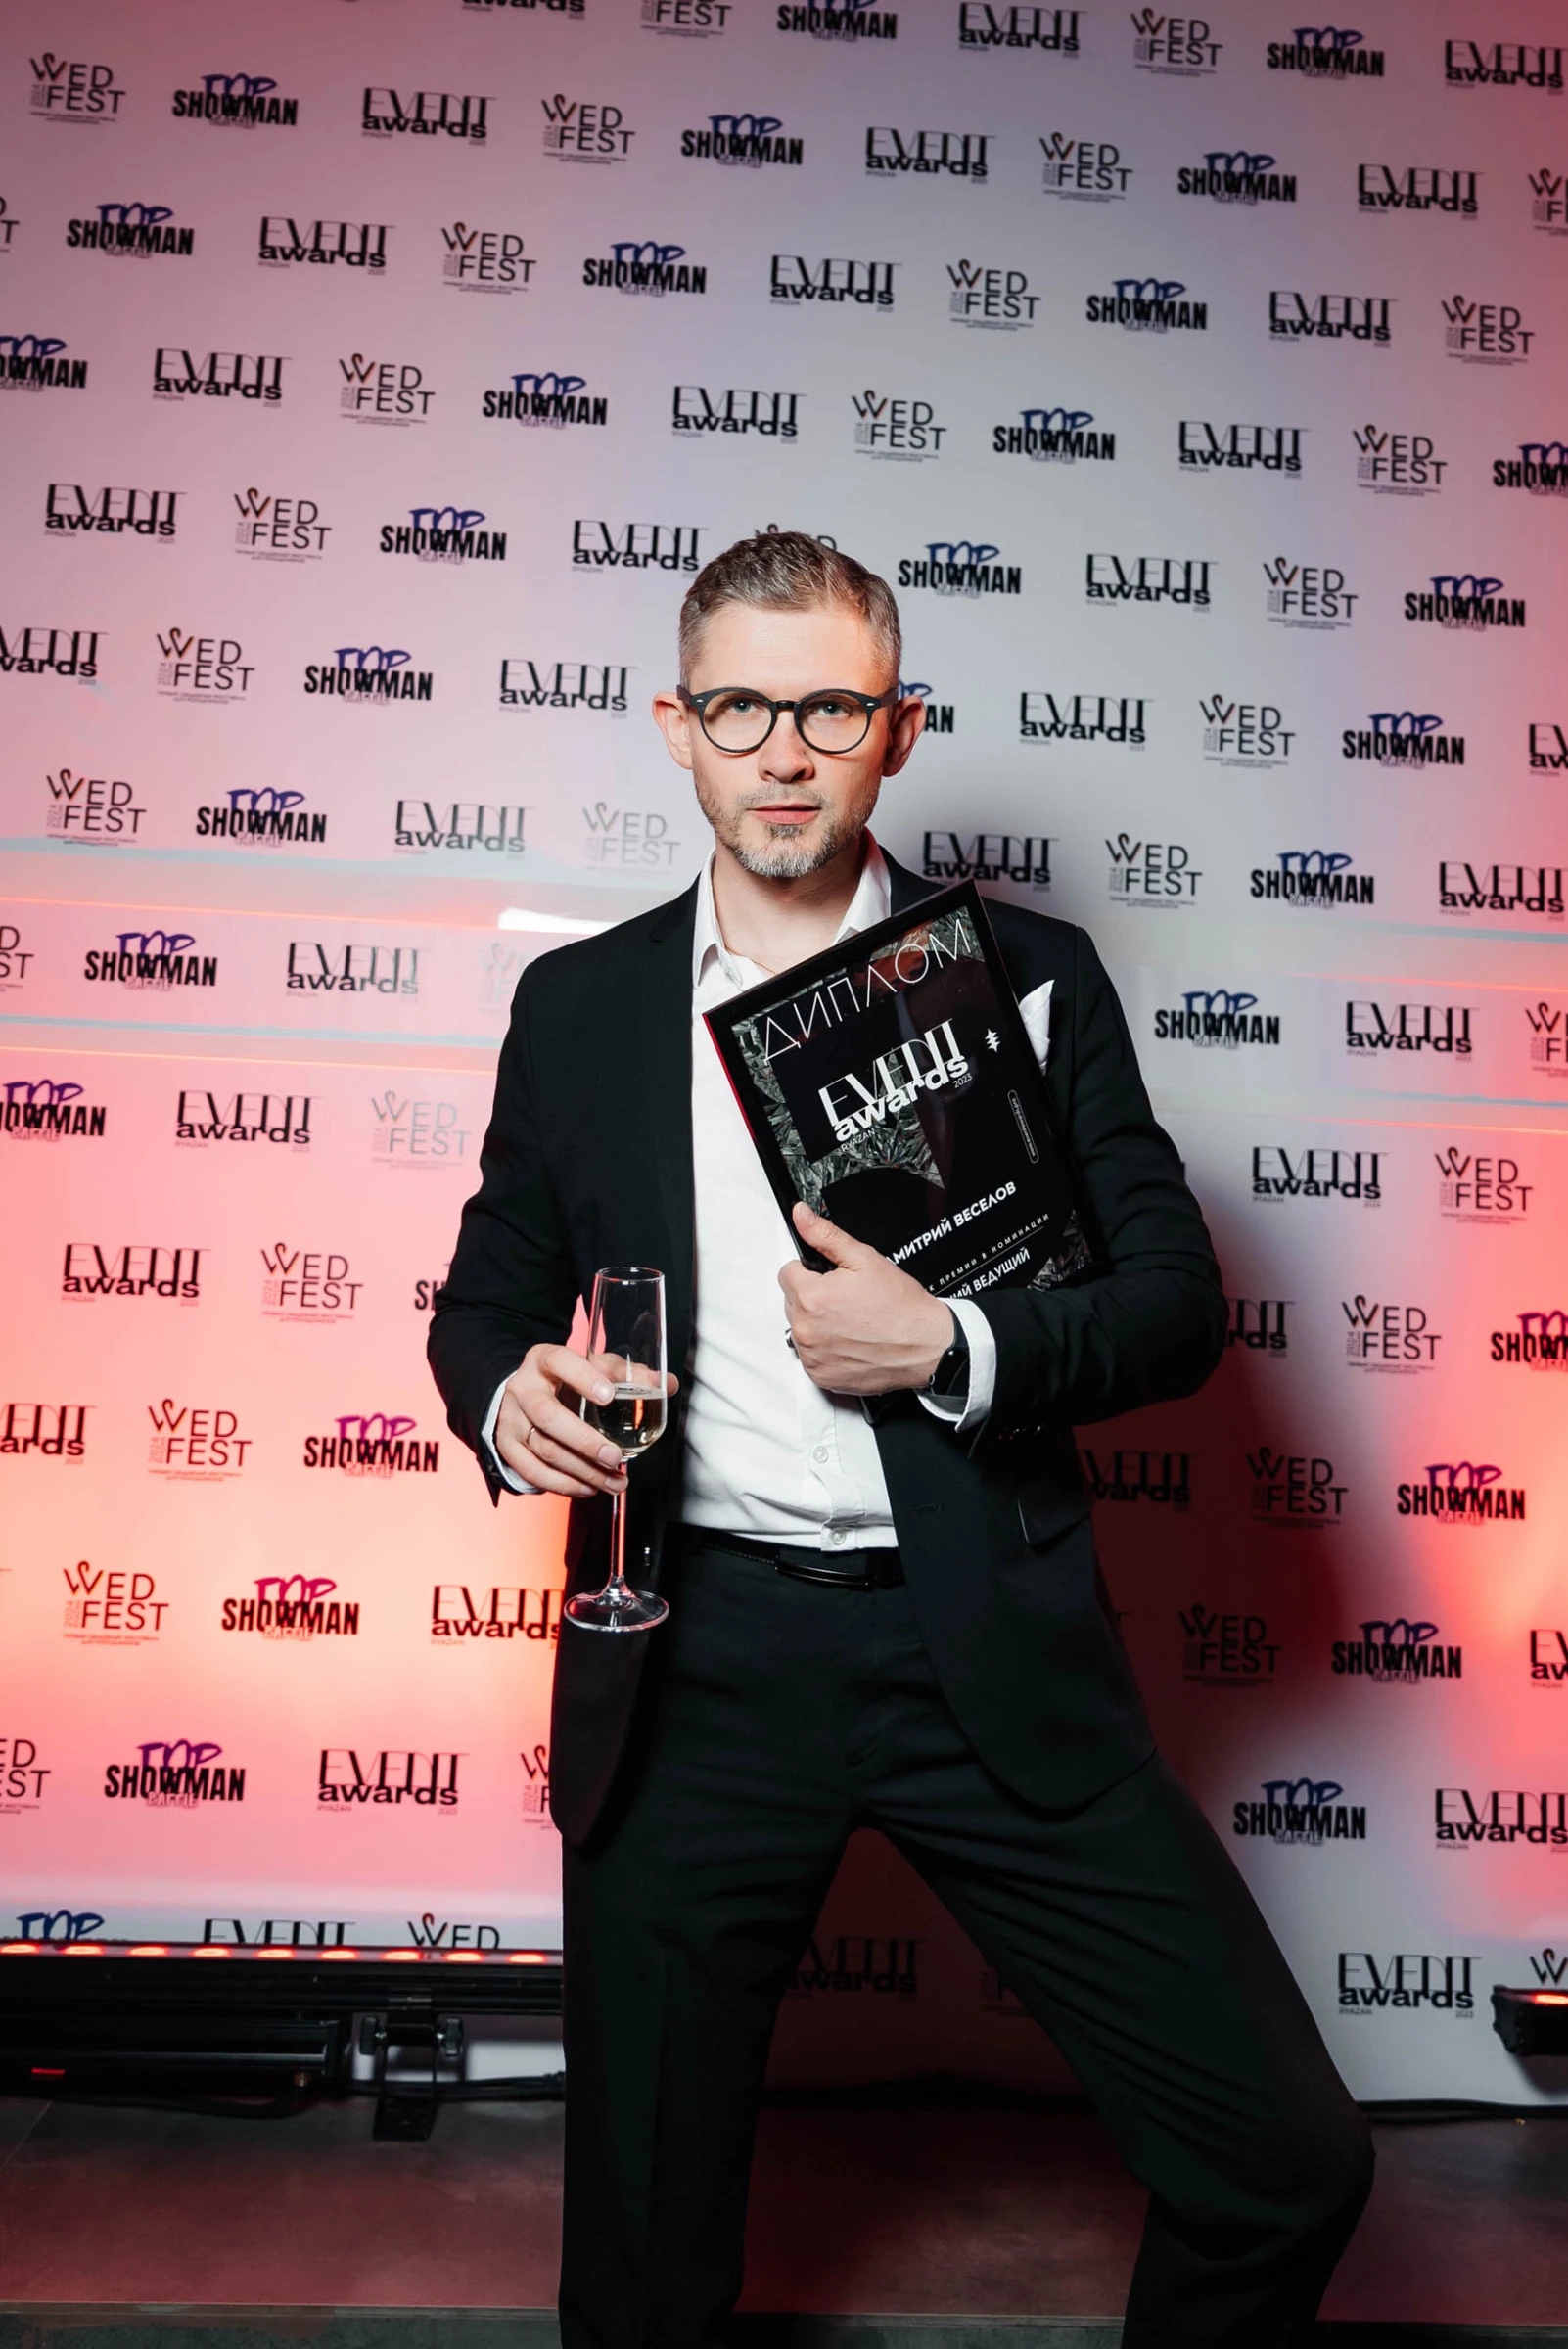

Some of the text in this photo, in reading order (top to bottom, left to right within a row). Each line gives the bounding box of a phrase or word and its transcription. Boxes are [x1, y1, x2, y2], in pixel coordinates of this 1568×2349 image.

[777, 5, 898, 40] SHOWMAN
[959, 2, 1087, 39] EVENT
[958, 29, 1079, 52] awards
[30, 52, 113, 88] WED
[202, 72, 277, 100] TOP
[47, 85, 126, 114] FEST
[173, 90, 298, 125] SHOWMAN
[362, 87, 497, 126] EVENT
[541, 94, 622, 129] WED
[361, 115, 487, 139] awards
[559, 126, 635, 154] FEST
[709, 113, 782, 139] TOP
[682, 130, 803, 165] SHOWMAN
[866, 126, 996, 164] EVENT
[865, 155, 988, 177] awards
[1203, 151, 1275, 176] TOP
[1177, 168, 1296, 202] SHOWMAN
[97, 202, 173, 229] TOP
[68, 220, 194, 255] SHOWMAN
[259, 216, 396, 255] EVENT
[441, 221, 523, 257] WED
[258, 245, 386, 268] awards
[459, 255, 536, 283] FEST
[611, 241, 686, 267] TOP
[583, 259, 707, 294] SHOWMAN
[770, 254, 902, 293] EVENT
[946, 259, 1027, 295] WED
[1112, 277, 1186, 303] TOP
[770, 283, 894, 305] awards
[965, 292, 1040, 319] FEST
[1269, 291, 1398, 328] EVENT
[1086, 296, 1207, 330] SHOWMAN
[1269, 319, 1391, 341] awards
[154, 348, 293, 388] EVENT
[339, 352, 422, 390] WED
[511, 372, 586, 398] TOP
[153, 377, 282, 400] awards
[356, 387, 436, 415] FEST
[672, 386, 807, 424] EVENT
[484, 391, 608, 425] SHOWMAN
[852, 390, 933, 425] WED
[1019, 407, 1094, 434] TOP
[671, 414, 798, 437] awards
[870, 423, 946, 450] FEST
[1178, 420, 1310, 458] EVENT
[1353, 424, 1433, 459] WED
[993, 426, 1115, 460] SHOWMAN
[1178, 449, 1302, 472] awards
[1373, 457, 1447, 484] FEST
[46, 484, 187, 523] EVENT
[234, 487, 318, 525] WED
[408, 506, 485, 533] TOP
[44, 513, 176, 536] awards
[252, 522, 332, 550] FEST
[381, 526, 507, 560] SHOWMAN
[925, 540, 999, 568] TOP
[899, 560, 1021, 594] SHOWMAN
[1086, 553, 1219, 591] EVENT
[1263, 557, 1344, 592] WED
[1429, 574, 1503, 601] TOP
[1085, 582, 1211, 605] awards
[1283, 590, 1358, 618] FEST
[1404, 593, 1525, 627] SHOWMAN
[156, 627, 241, 665] WED
[334, 645, 412, 673] TOP
[174, 663, 255, 691] FEST
[305, 666, 433, 700] SHOWMAN
[500, 659, 638, 698] EVENT
[499, 689, 628, 712] awards
[1020, 691, 1154, 730] EVENT
[1199, 694, 1281, 730] WED
[1019, 721, 1146, 744] awards
[1368, 711, 1443, 738] TOP
[1220, 728, 1295, 756] FEST
[1342, 730, 1464, 764] SHOWMAN
[46, 768, 132, 806] WED
[226, 786, 305, 815] TOP
[64, 805, 147, 834] FEST
[197, 807, 327, 843] SHOWMAN
[394, 800, 535, 839] EVENT
[393, 830, 526, 852] awards
[1105, 833, 1188, 869] WED
[1276, 849, 1353, 877] TOP
[1126, 868, 1203, 896] FEST
[1250, 870, 1374, 904] SHOWMAN
[1440, 861, 1568, 900] EVENT
[1439, 892, 1565, 914] awards
[115, 929, 196, 958] TOP
[85, 951, 218, 986] SHOWMAN
[287, 942, 431, 981] EVENT
[285, 973, 420, 995] awards
[763, 918, 972, 1067] ДИПЛОМ
[1181, 989, 1258, 1017] TOP
[1346, 1001, 1480, 1039] EVENT
[1154, 1010, 1280, 1044] SHOWMAN
[1346, 1032, 1472, 1054] awards
[818, 1018, 965, 1127] EVENT
[952, 1073, 973, 1089] 2023
[176, 1090, 322, 1130] EVENT
[834, 1054, 969, 1142] awards
[175, 1123, 311, 1144] awards
[840, 1128, 877, 1153] RYAZAN
[1253, 1146, 1389, 1185] EVENT
[1434, 1146, 1519, 1184] WED
[953, 1181, 1017, 1227] ВЕСЕЛОВ
[1252, 1177, 1381, 1200] awards
[1456, 1183, 1533, 1212] FEST
[63, 1243, 211, 1283] EVENT
[260, 1242, 348, 1281] WED
[939, 1258, 978, 1286] ПРЕМИИ
[991, 1213, 1049, 1254] НОМИНАЦИИ
[973, 1246, 1031, 1291] ВЕДУЩИЙ
[61, 1276, 200, 1298] awards
[279, 1280, 363, 1310] FEST
[1342, 1295, 1427, 1332] WED
[1363, 1332, 1442, 1360] FEST
[148, 1398, 237, 1438] WED
[334, 1412, 416, 1444] TOP
[166, 1437, 253, 1467] FEST
[304, 1437, 438, 1472] SHOWMAN
[1424, 1460, 1502, 1492] TOP
[1397, 1485, 1526, 1520] SHOWMAN
[63, 1560, 155, 1600] WED
[254, 1573, 337, 1605] TOP
[81, 1600, 169, 1631] FEST
[222, 1599, 360, 1635] SHOWMAN
[1360, 1618, 1439, 1649] TOP
[1331, 1643, 1461, 1678] SHOWMAN
[137, 1738, 223, 1771] TOP
[318, 1749, 470, 1790] EVENT
[106, 1765, 246, 1801] SHOWMAN
[317, 1784, 459, 1806] awards
[1262, 1777, 1343, 1810] TOP
[1233, 1803, 1366, 1839] SHOWMAN
[1435, 1788, 1568, 1829] EVENT
[1436, 1822, 1568, 1844] awards
[1339, 1953, 1482, 1994] EVENT
[1339, 1988, 1474, 2009] awards
